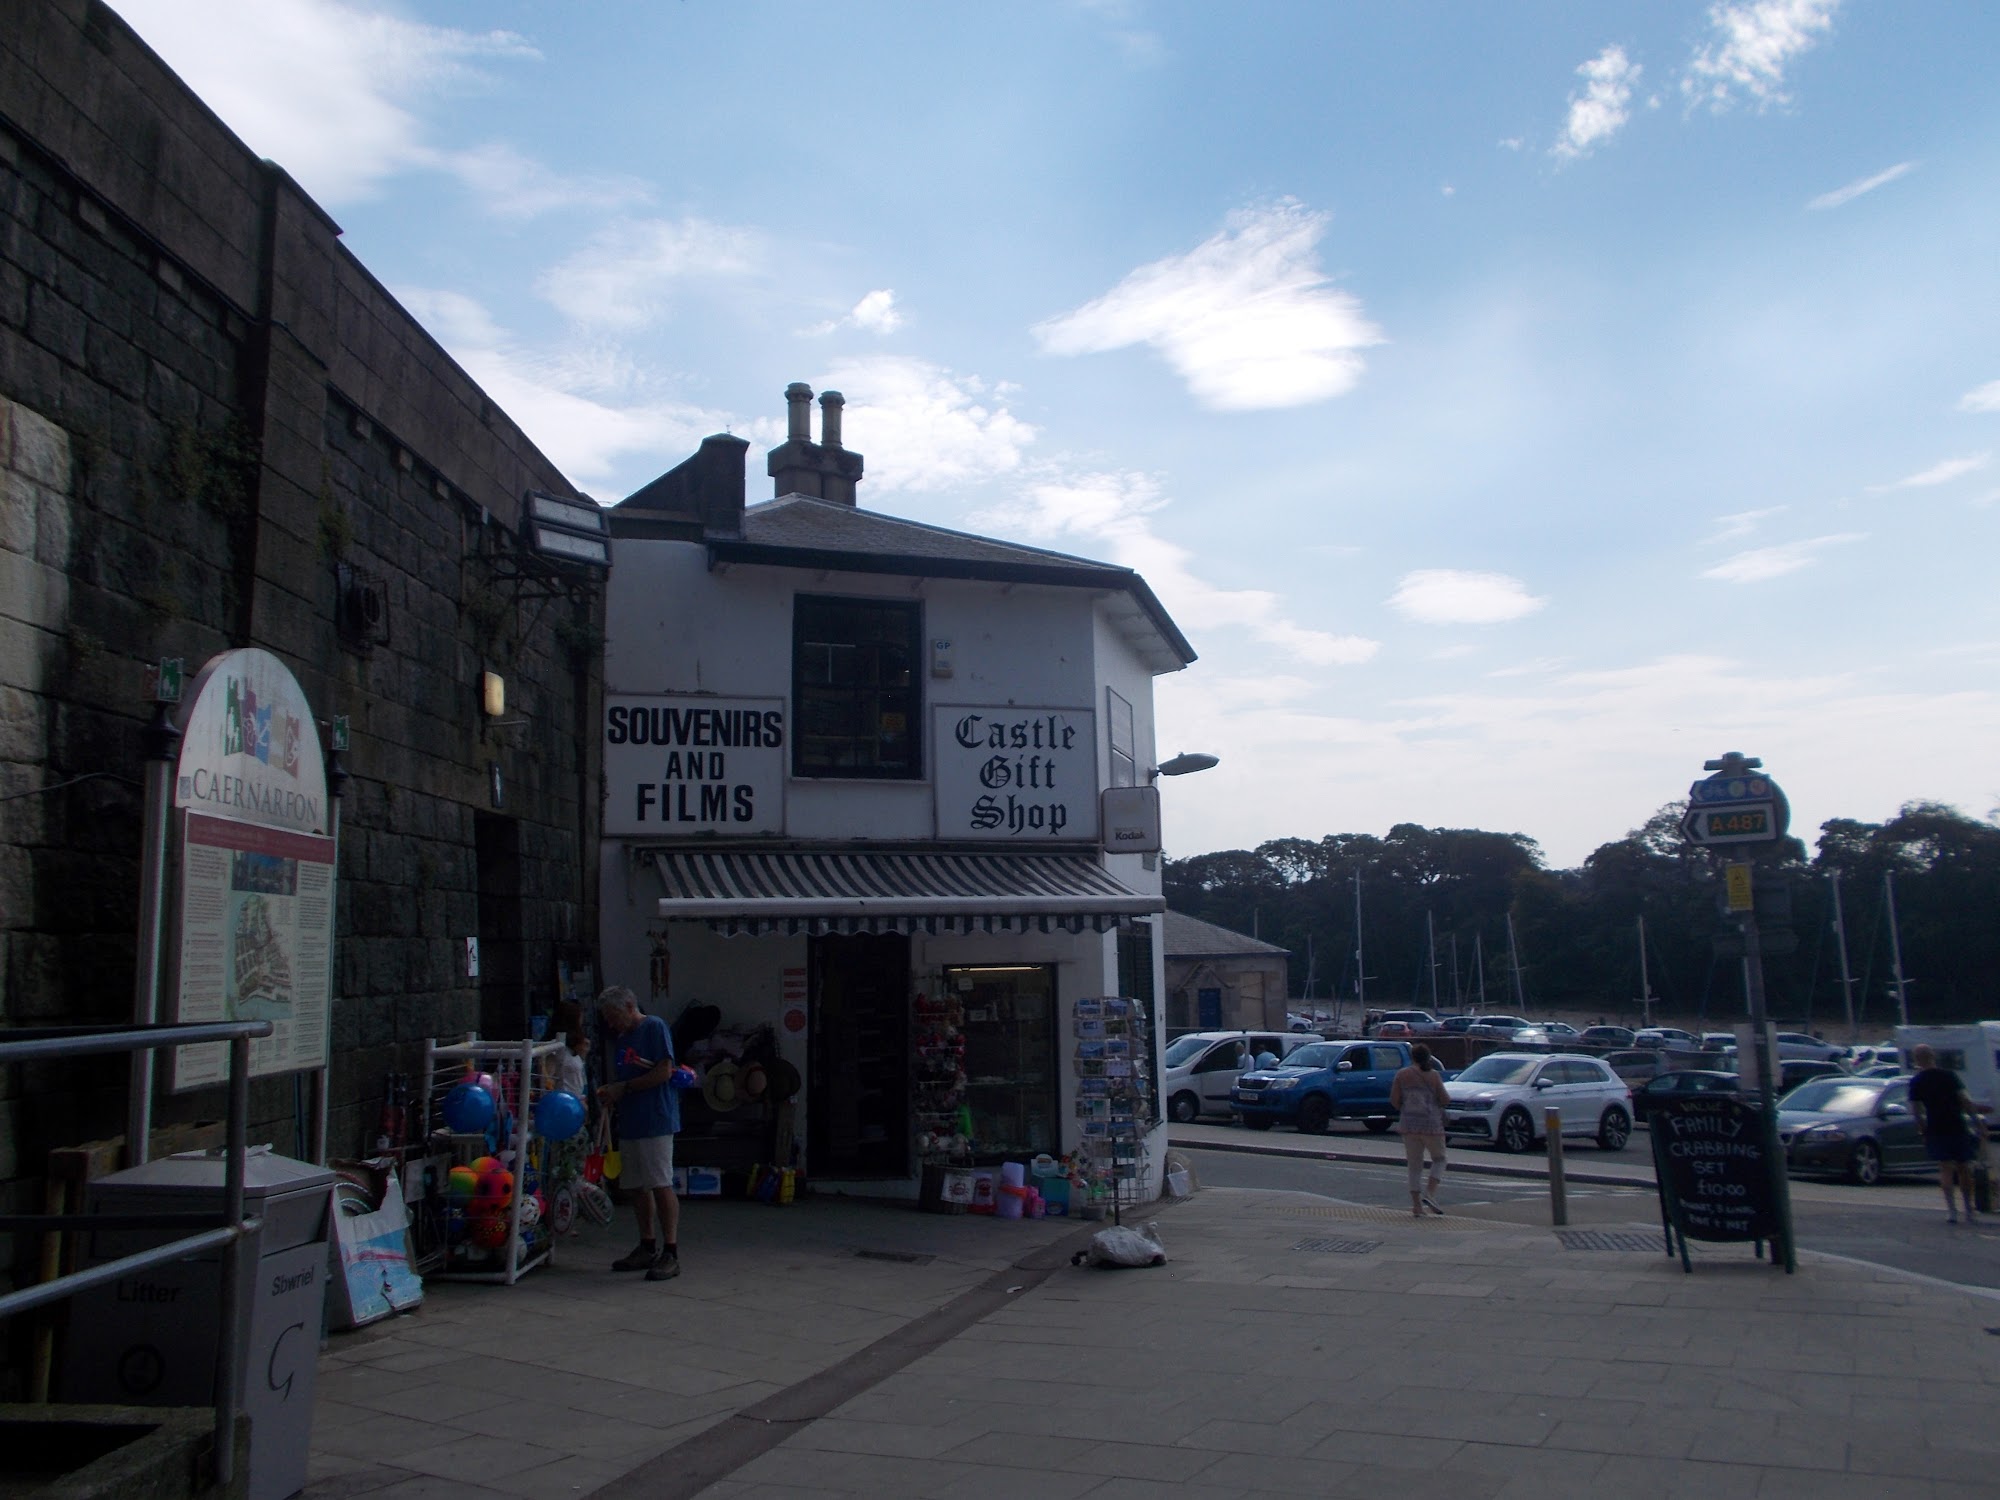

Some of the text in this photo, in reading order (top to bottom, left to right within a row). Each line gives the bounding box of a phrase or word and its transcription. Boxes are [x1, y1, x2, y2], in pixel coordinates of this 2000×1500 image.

[936, 641, 951, 650] GP
[608, 706, 782, 748] SOUVENIRS
[955, 714, 1076, 750] Castle
[665, 751, 724, 780] AND
[979, 754, 1056, 789] Gift
[193, 768, 318, 823] CAERNARFON
[637, 783, 753, 822] FILMS
[970, 794, 1067, 836] Shop
[1115, 831, 1146, 841] Kodak
[1669, 1115, 1743, 1138] FAMILY
[1669, 1140, 1760, 1160] CRABBING
[1692, 1160, 1725, 1174] SET
[117, 1280, 182, 1302] Litter
[271, 1265, 315, 1296] Sbwriel
